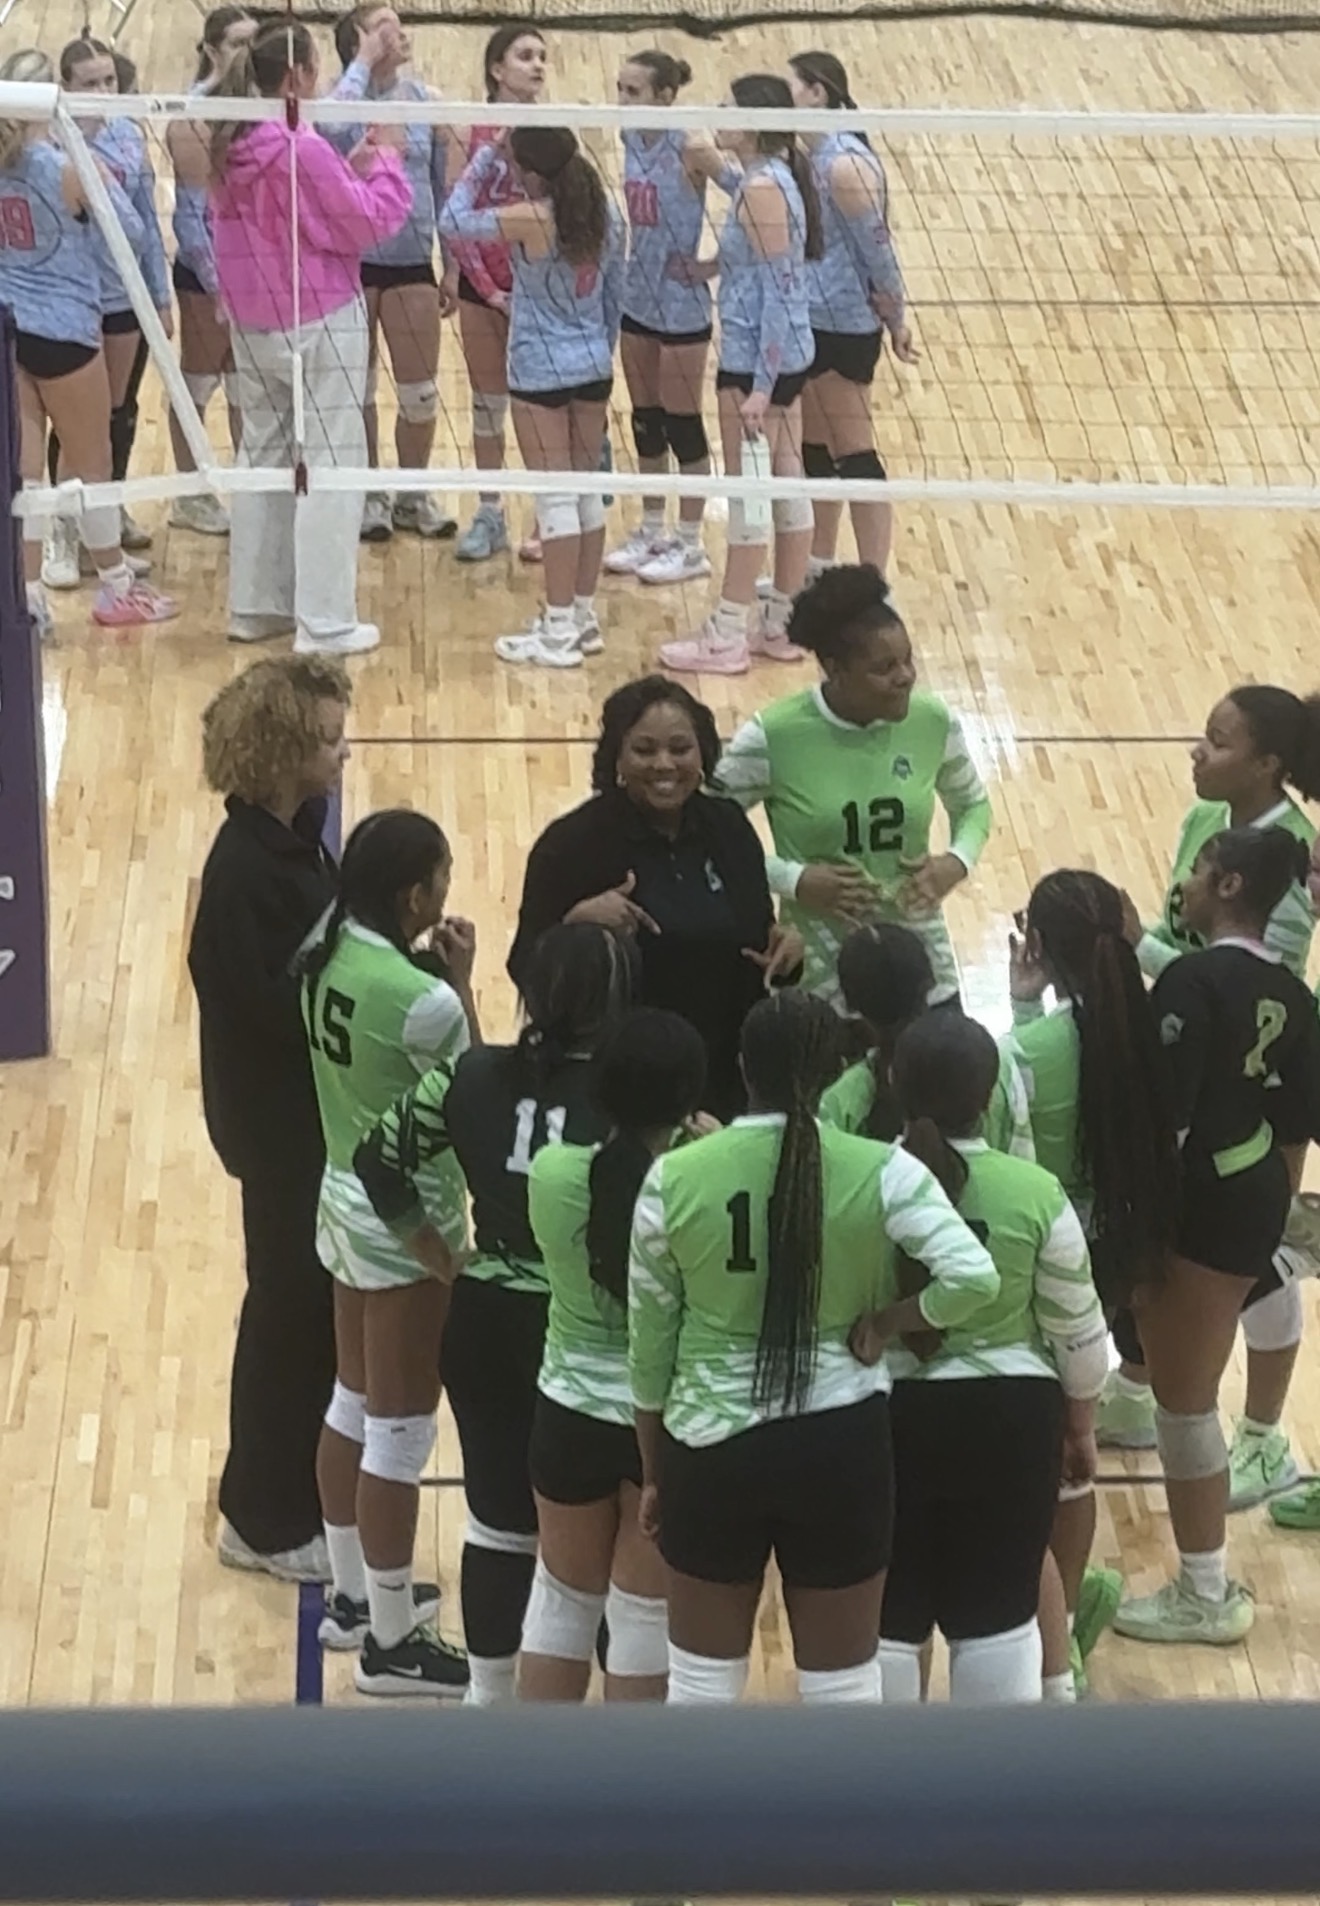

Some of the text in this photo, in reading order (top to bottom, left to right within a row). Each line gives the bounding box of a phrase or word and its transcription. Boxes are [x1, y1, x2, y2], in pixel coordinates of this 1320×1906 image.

[842, 797, 904, 854] 12
[308, 984, 355, 1068] 15
[506, 1098, 566, 1174] 11
